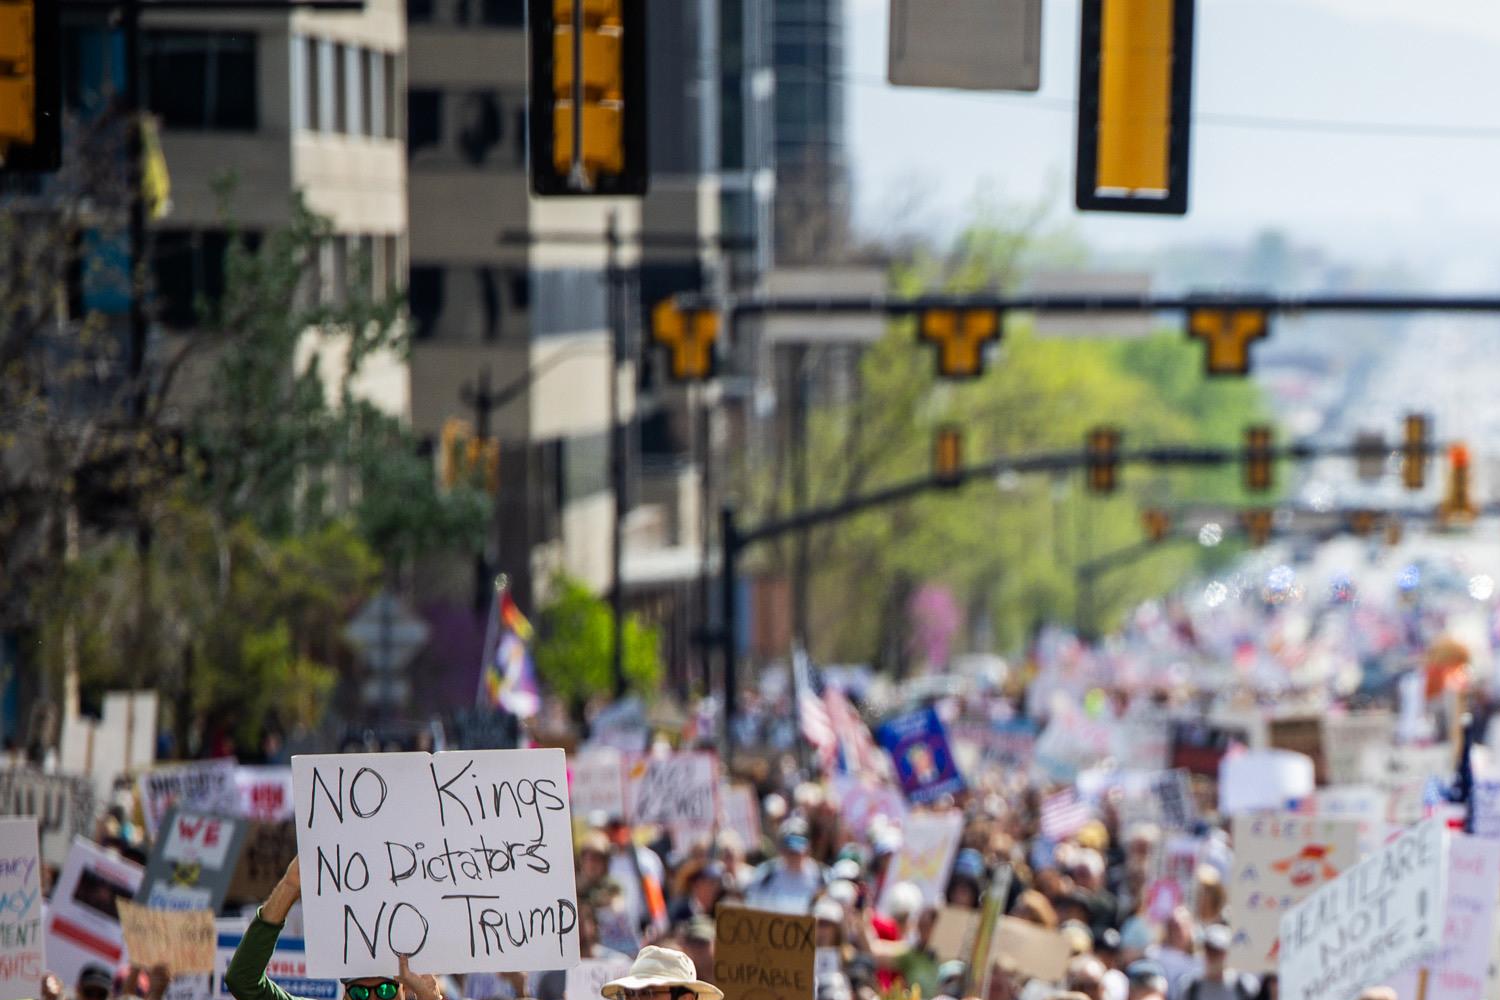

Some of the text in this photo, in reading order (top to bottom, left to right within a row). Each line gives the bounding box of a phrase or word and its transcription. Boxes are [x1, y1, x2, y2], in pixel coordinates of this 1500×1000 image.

[308, 767, 387, 828] NO
[430, 760, 565, 842] Kings
[317, 844, 369, 896] NO
[384, 835, 550, 886] Dictators
[344, 902, 428, 964] NO
[768, 918, 816, 952] COX
